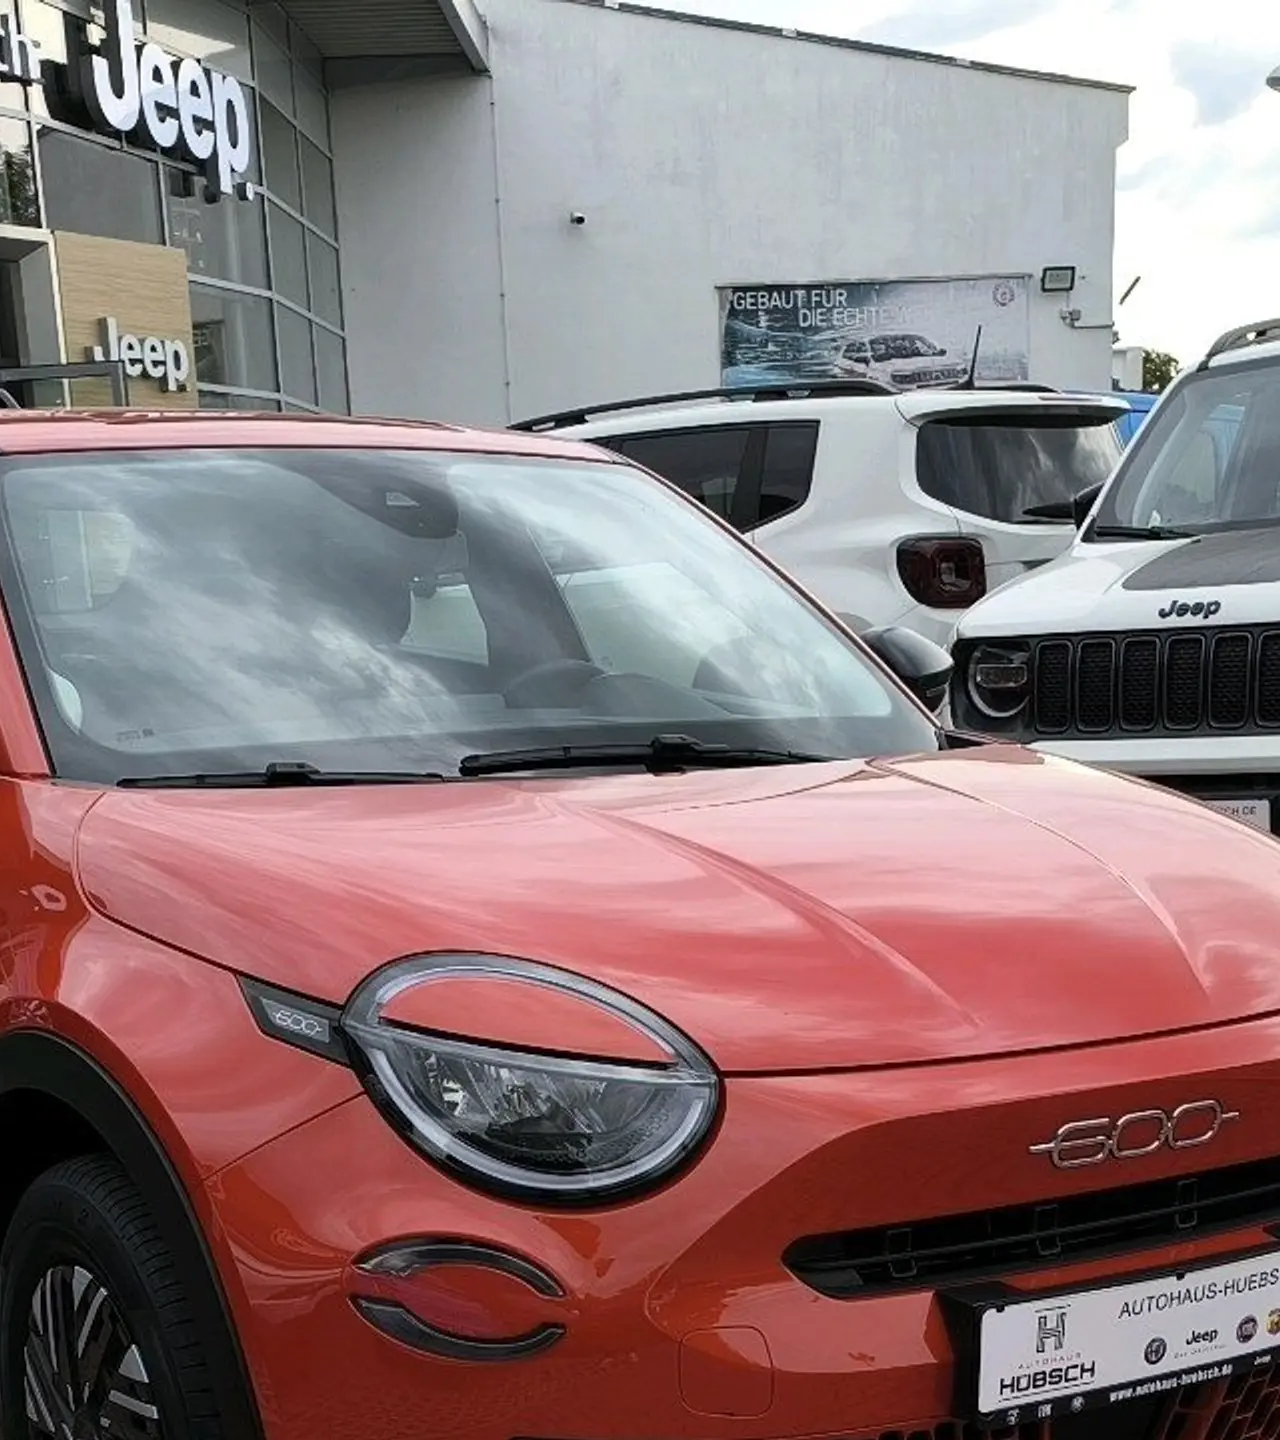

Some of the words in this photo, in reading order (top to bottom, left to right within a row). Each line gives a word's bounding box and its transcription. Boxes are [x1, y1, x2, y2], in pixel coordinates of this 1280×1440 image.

[92, 0, 250, 195] Jeep
[733, 290, 803, 310] GEBAUT
[811, 286, 848, 309] FÜR
[799, 308, 827, 328] DIE
[93, 316, 189, 392] Jeep
[1158, 599, 1222, 620] Jeep
[272, 1009, 324, 1037] 600
[1046, 1099, 1230, 1169] 600
[1186, 1328, 1218, 1345] Jeep
